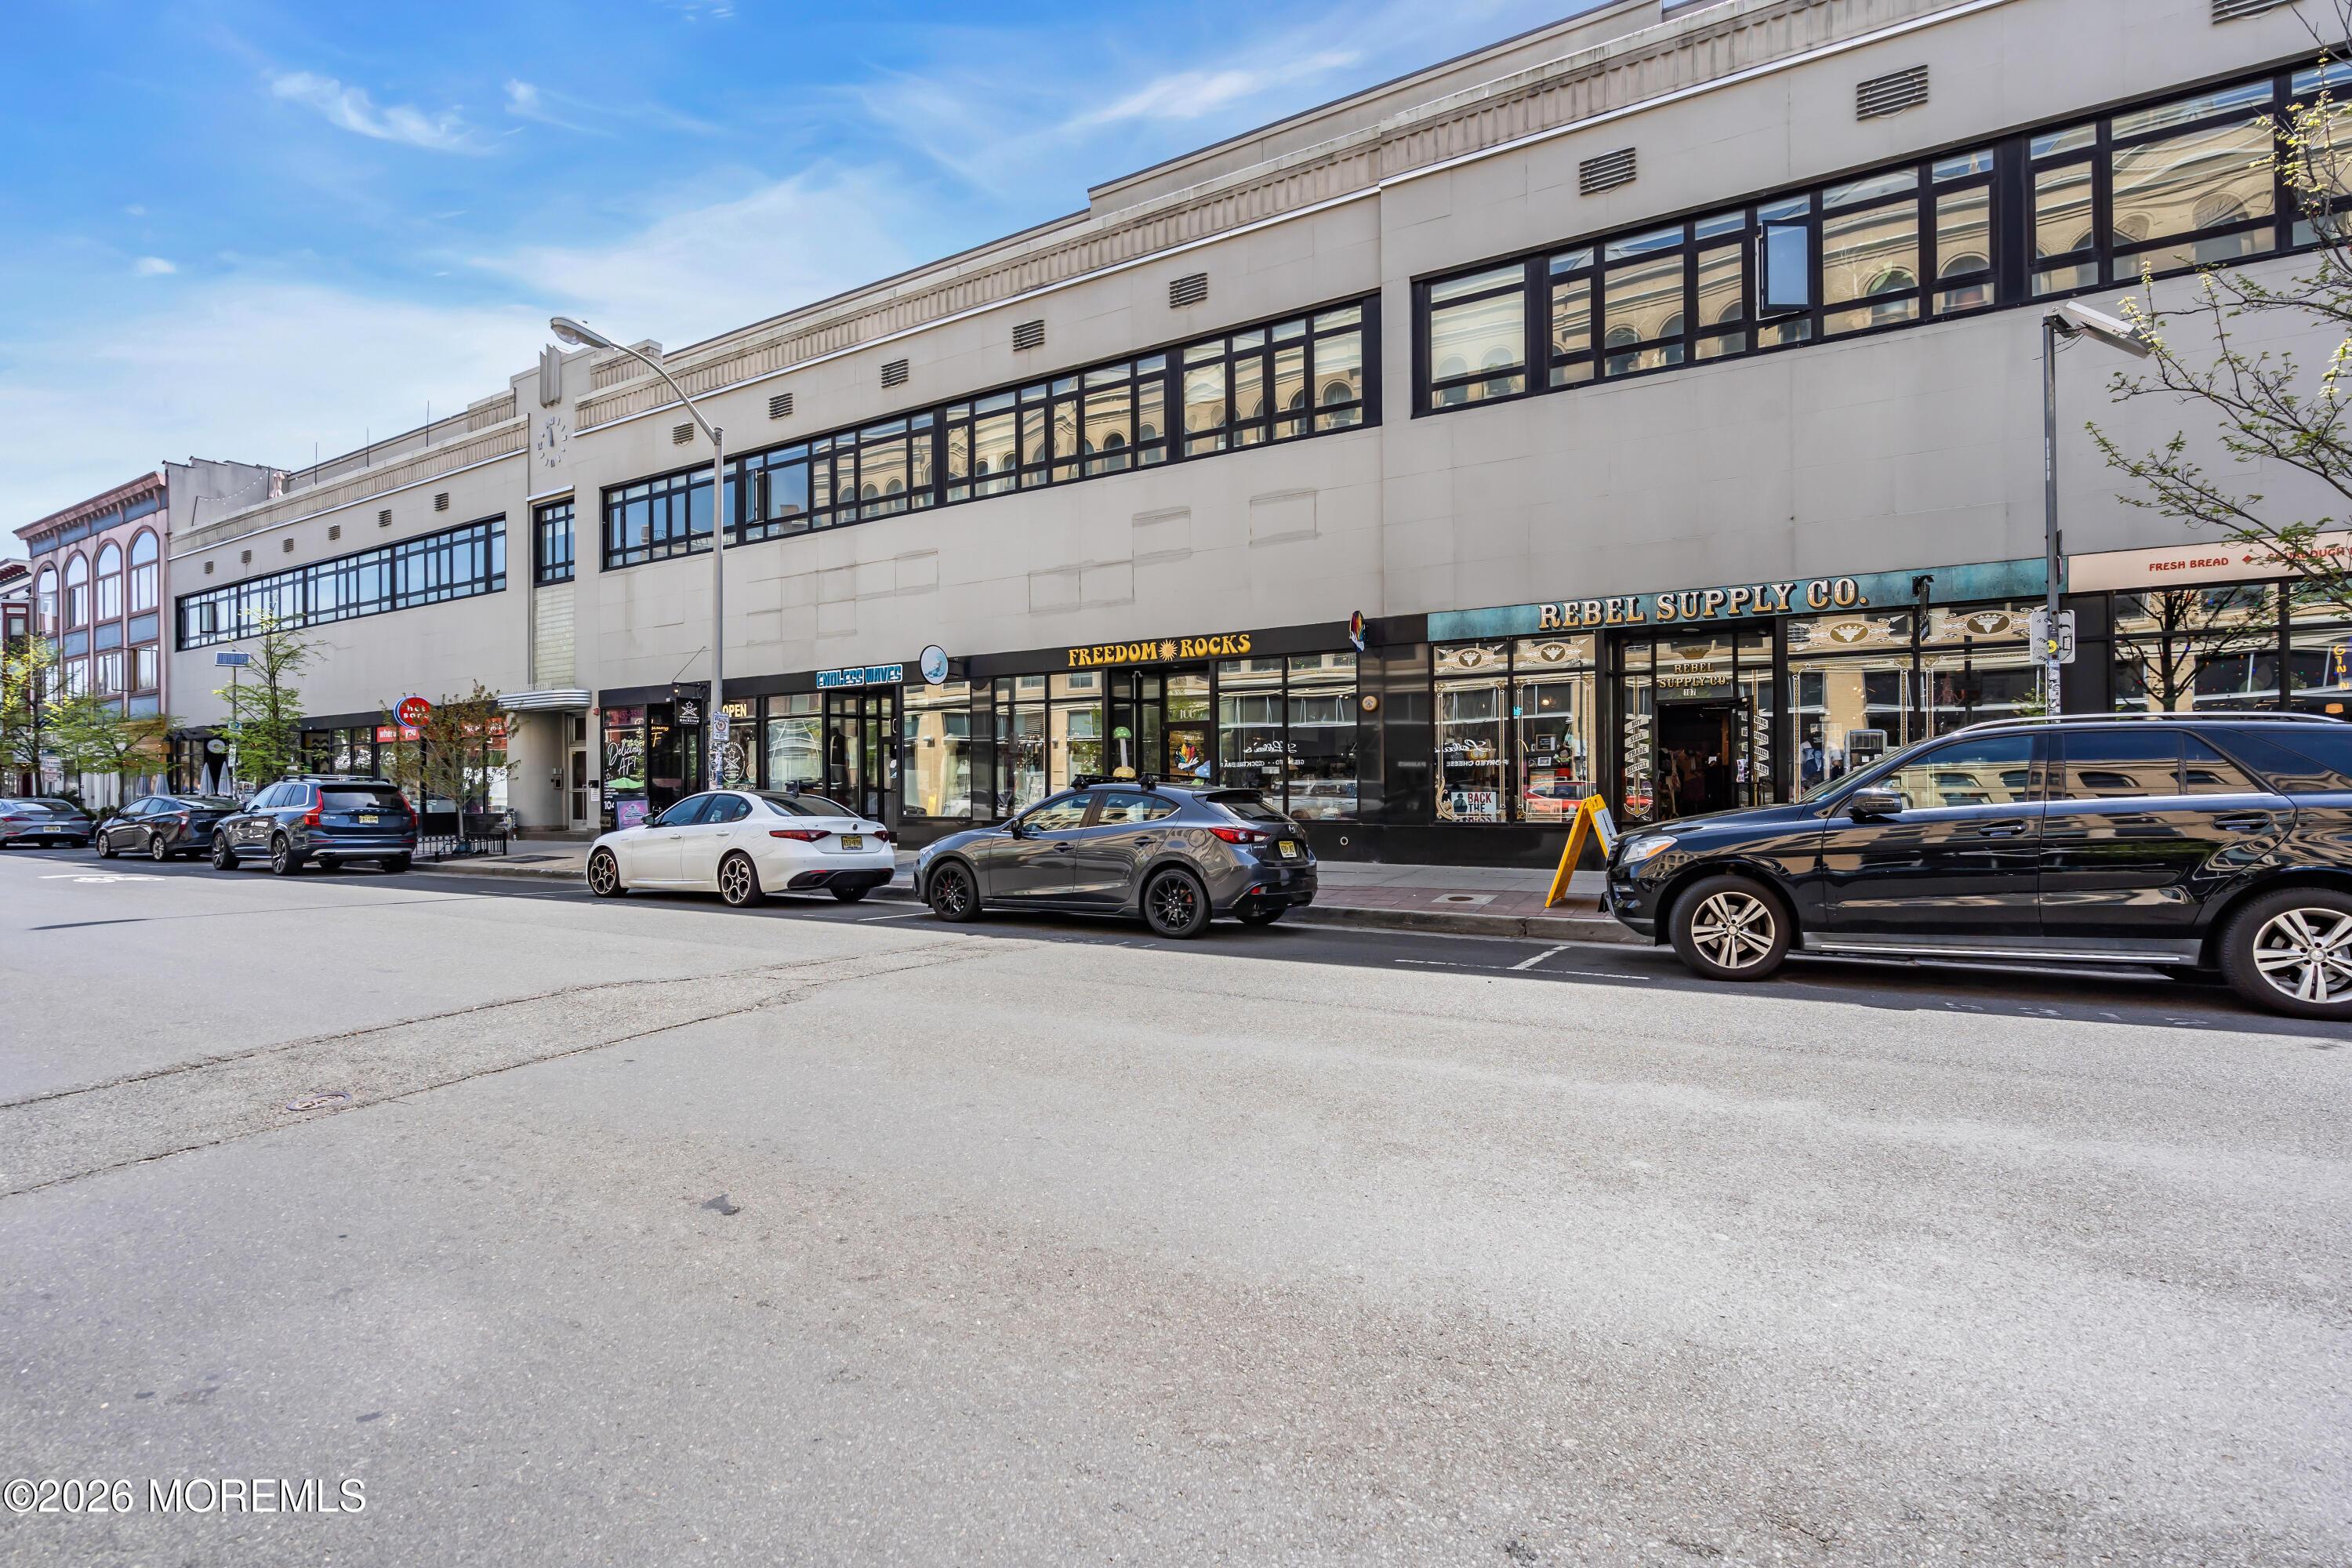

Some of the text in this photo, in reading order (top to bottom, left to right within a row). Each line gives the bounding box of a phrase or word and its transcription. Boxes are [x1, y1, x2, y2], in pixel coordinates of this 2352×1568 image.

[2149, 561, 2186, 572] FRESH
[2190, 557, 2229, 568] BREAD
[1538, 576, 1869, 629] REBEL SUPPLY CO.
[1068, 634, 1251, 666] FREEDOM ROCKS
[1674, 662, 1715, 673] REBEL
[817, 664, 902, 688] ENDLESS WAVES
[1659, 674, 1730, 688] SUPPLY CO.
[722, 703, 747, 718] OPEN
[1632, 718, 1642, 728] BUY
[405, 729, 416, 739] you
[1630, 733, 1644, 742] SELL
[1628, 746, 1646, 758] TRADE
[618, 756, 637, 776] AF!
[1627, 761, 1647, 774] RECYCLE
[1467, 792, 1492, 804] BACK
[1468, 803, 1485, 814] THE
